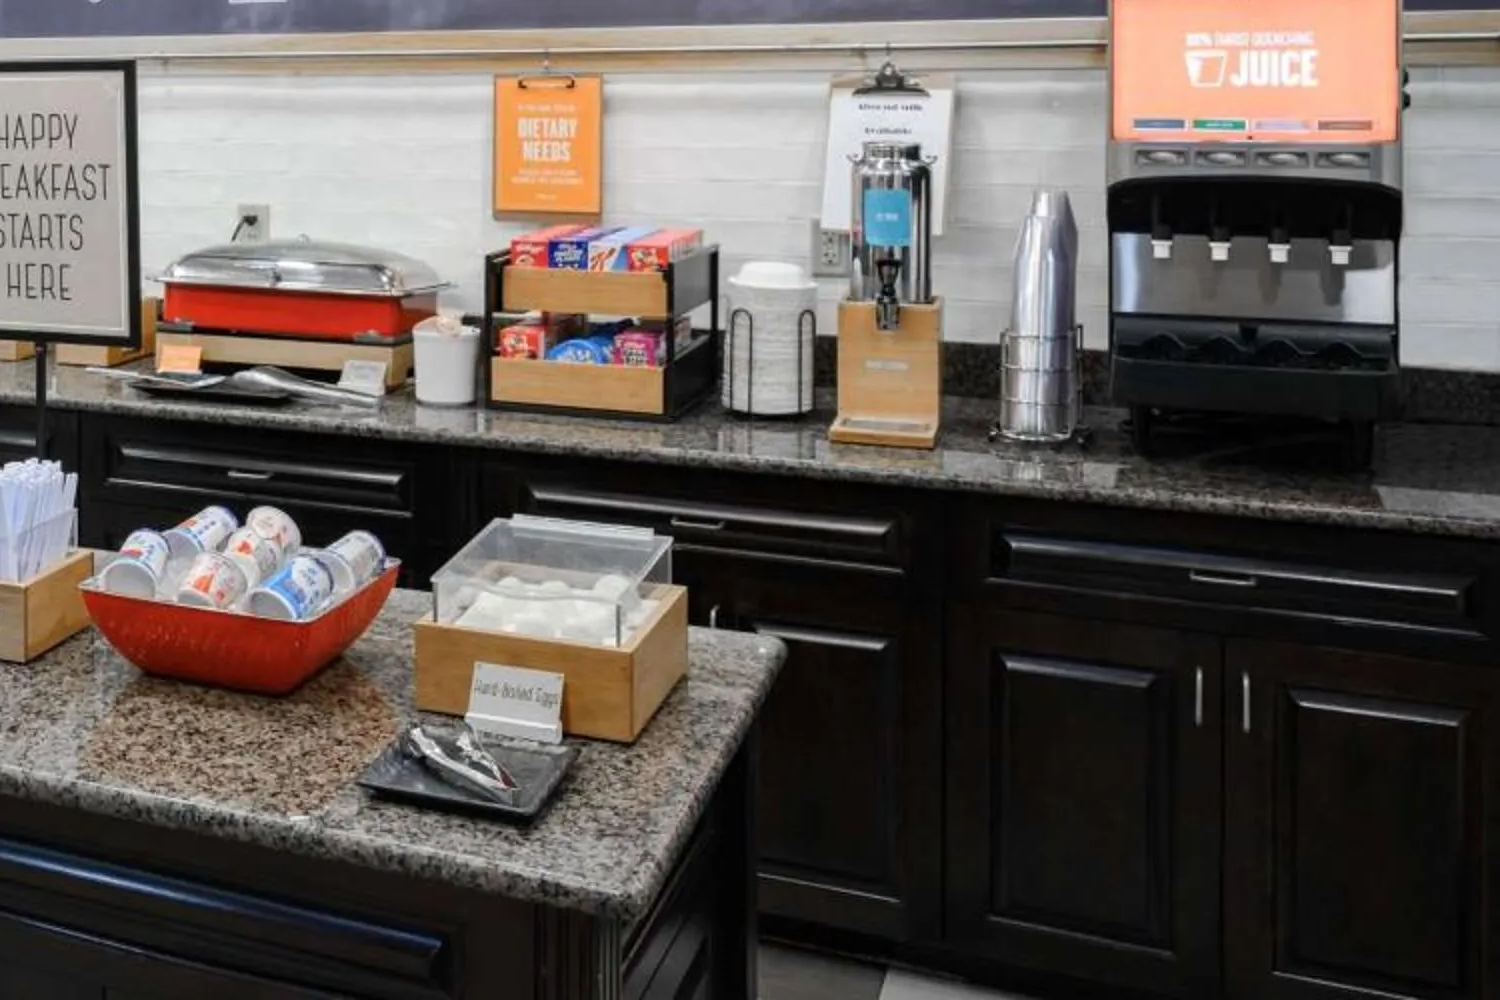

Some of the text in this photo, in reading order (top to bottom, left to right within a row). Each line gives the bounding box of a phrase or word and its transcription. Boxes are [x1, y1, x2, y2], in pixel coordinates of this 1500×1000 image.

[1229, 49, 1319, 87] JUICE
[518, 117, 577, 138] DIETARY
[523, 141, 571, 162] NEEDS
[6, 263, 73, 301] HERE
